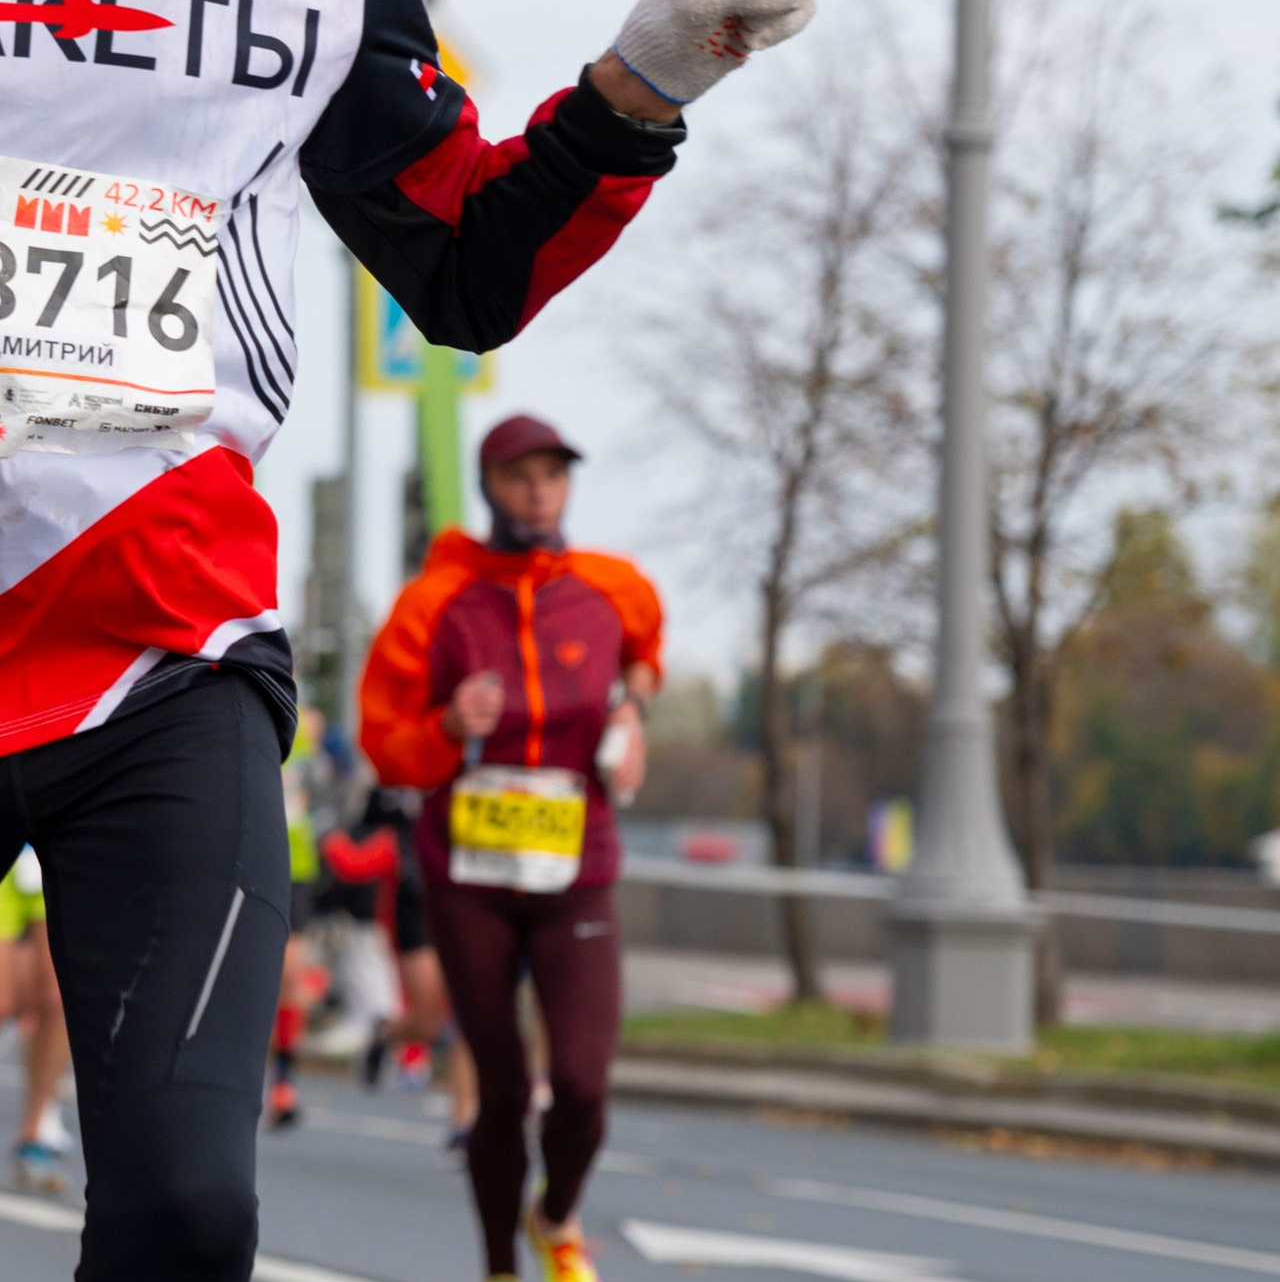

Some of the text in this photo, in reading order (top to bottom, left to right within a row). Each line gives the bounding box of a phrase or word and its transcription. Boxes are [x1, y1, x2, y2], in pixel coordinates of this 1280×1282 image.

[104, 181, 165, 212] 42,2
[133, 403, 180, 416] СИБУР
[26, 415, 78, 428] FONBET
